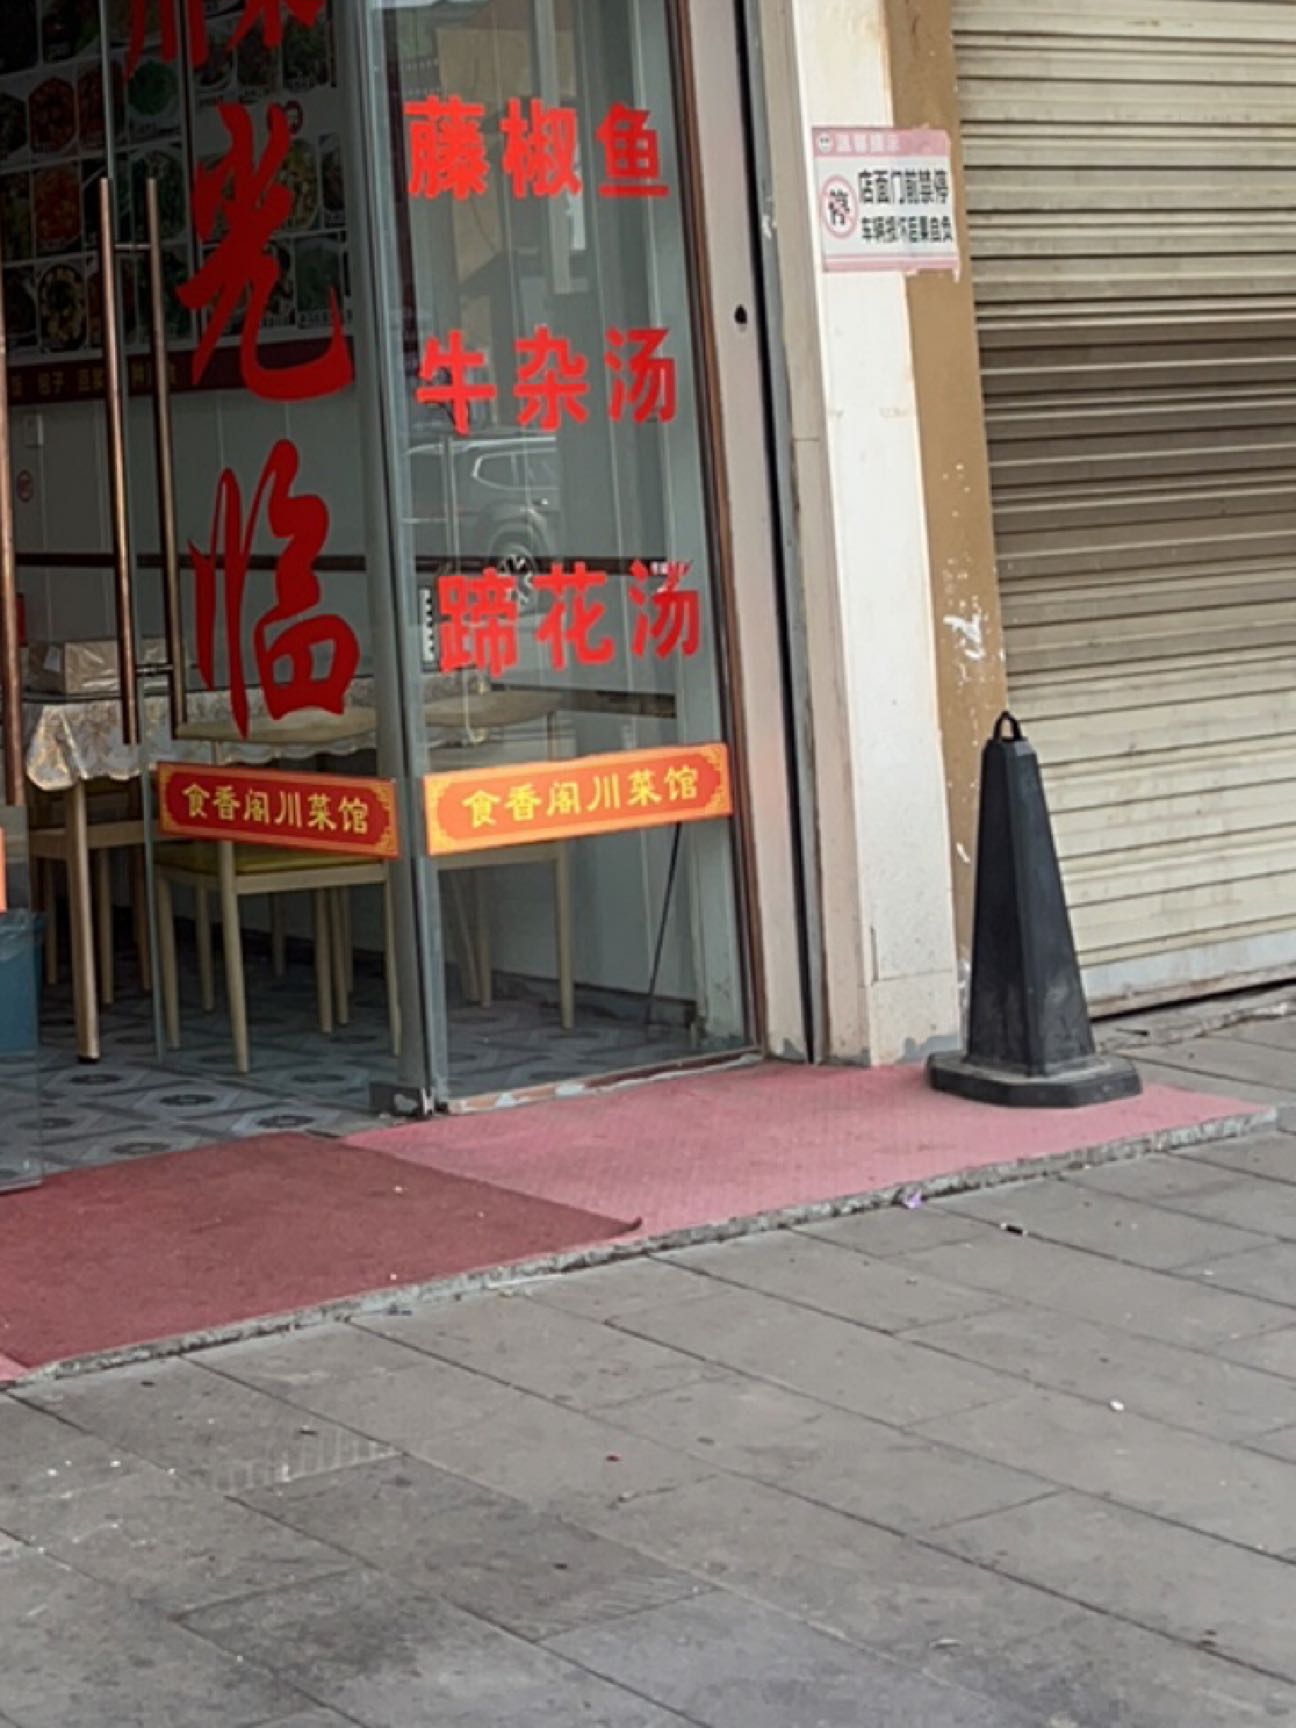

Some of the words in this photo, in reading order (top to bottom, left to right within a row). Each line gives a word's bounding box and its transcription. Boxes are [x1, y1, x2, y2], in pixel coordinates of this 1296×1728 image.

[403, 93, 670, 200] 藤椒鱼
[175, 102, 361, 740] 光临
[415, 324, 679, 436] 牛杂汤
[438, 559, 701, 678] 蹄花汤
[182, 782, 369, 835] 食香阁川菜馆
[462, 765, 700, 829] 食香阁川菜馆
